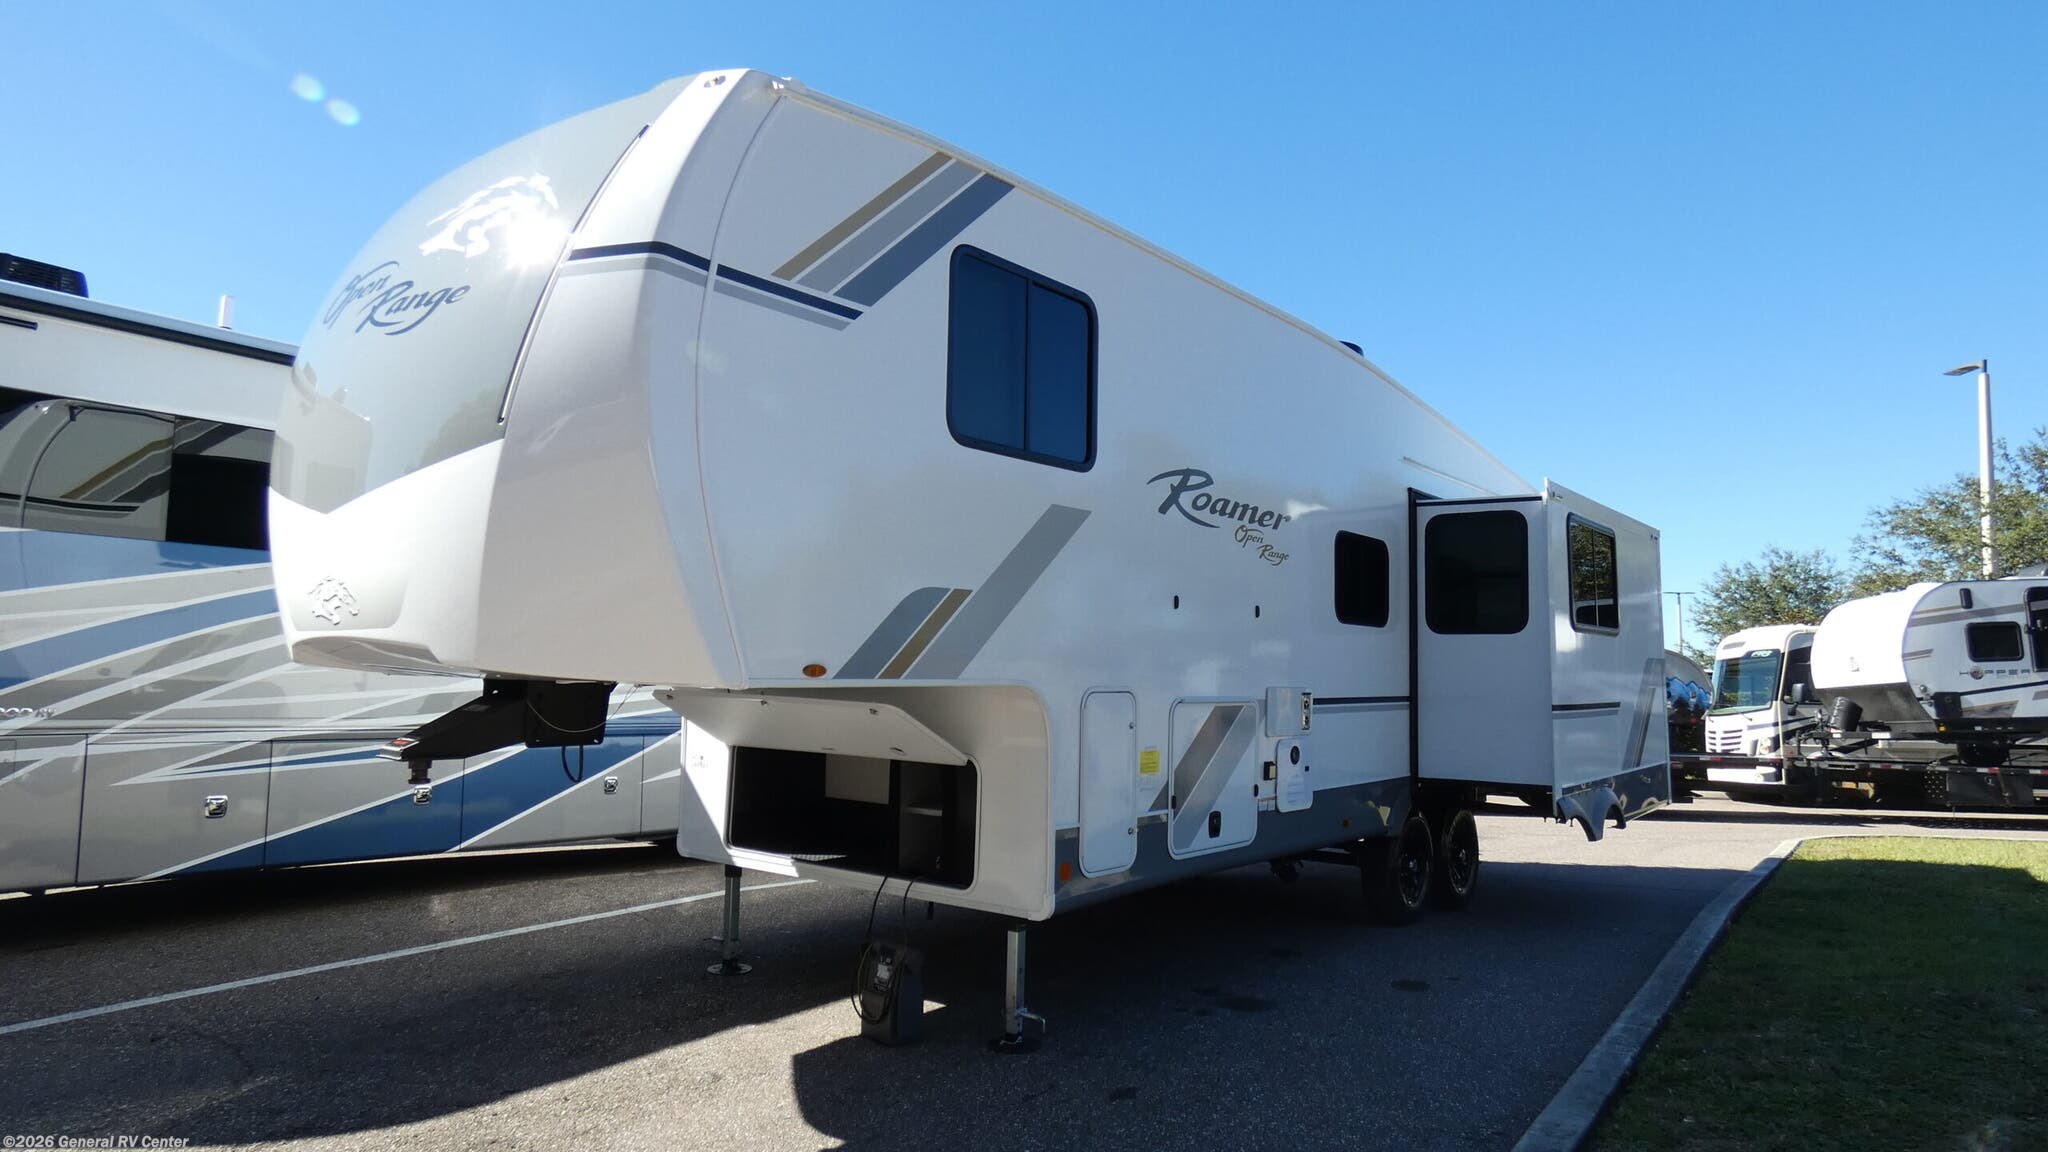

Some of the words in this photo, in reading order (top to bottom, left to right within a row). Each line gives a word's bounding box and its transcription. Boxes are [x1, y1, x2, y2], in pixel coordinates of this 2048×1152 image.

[355, 280, 471, 336] Range
[1146, 468, 1292, 530] Roamer
[1234, 525, 1264, 548] Open
[1256, 544, 1290, 566] Range
